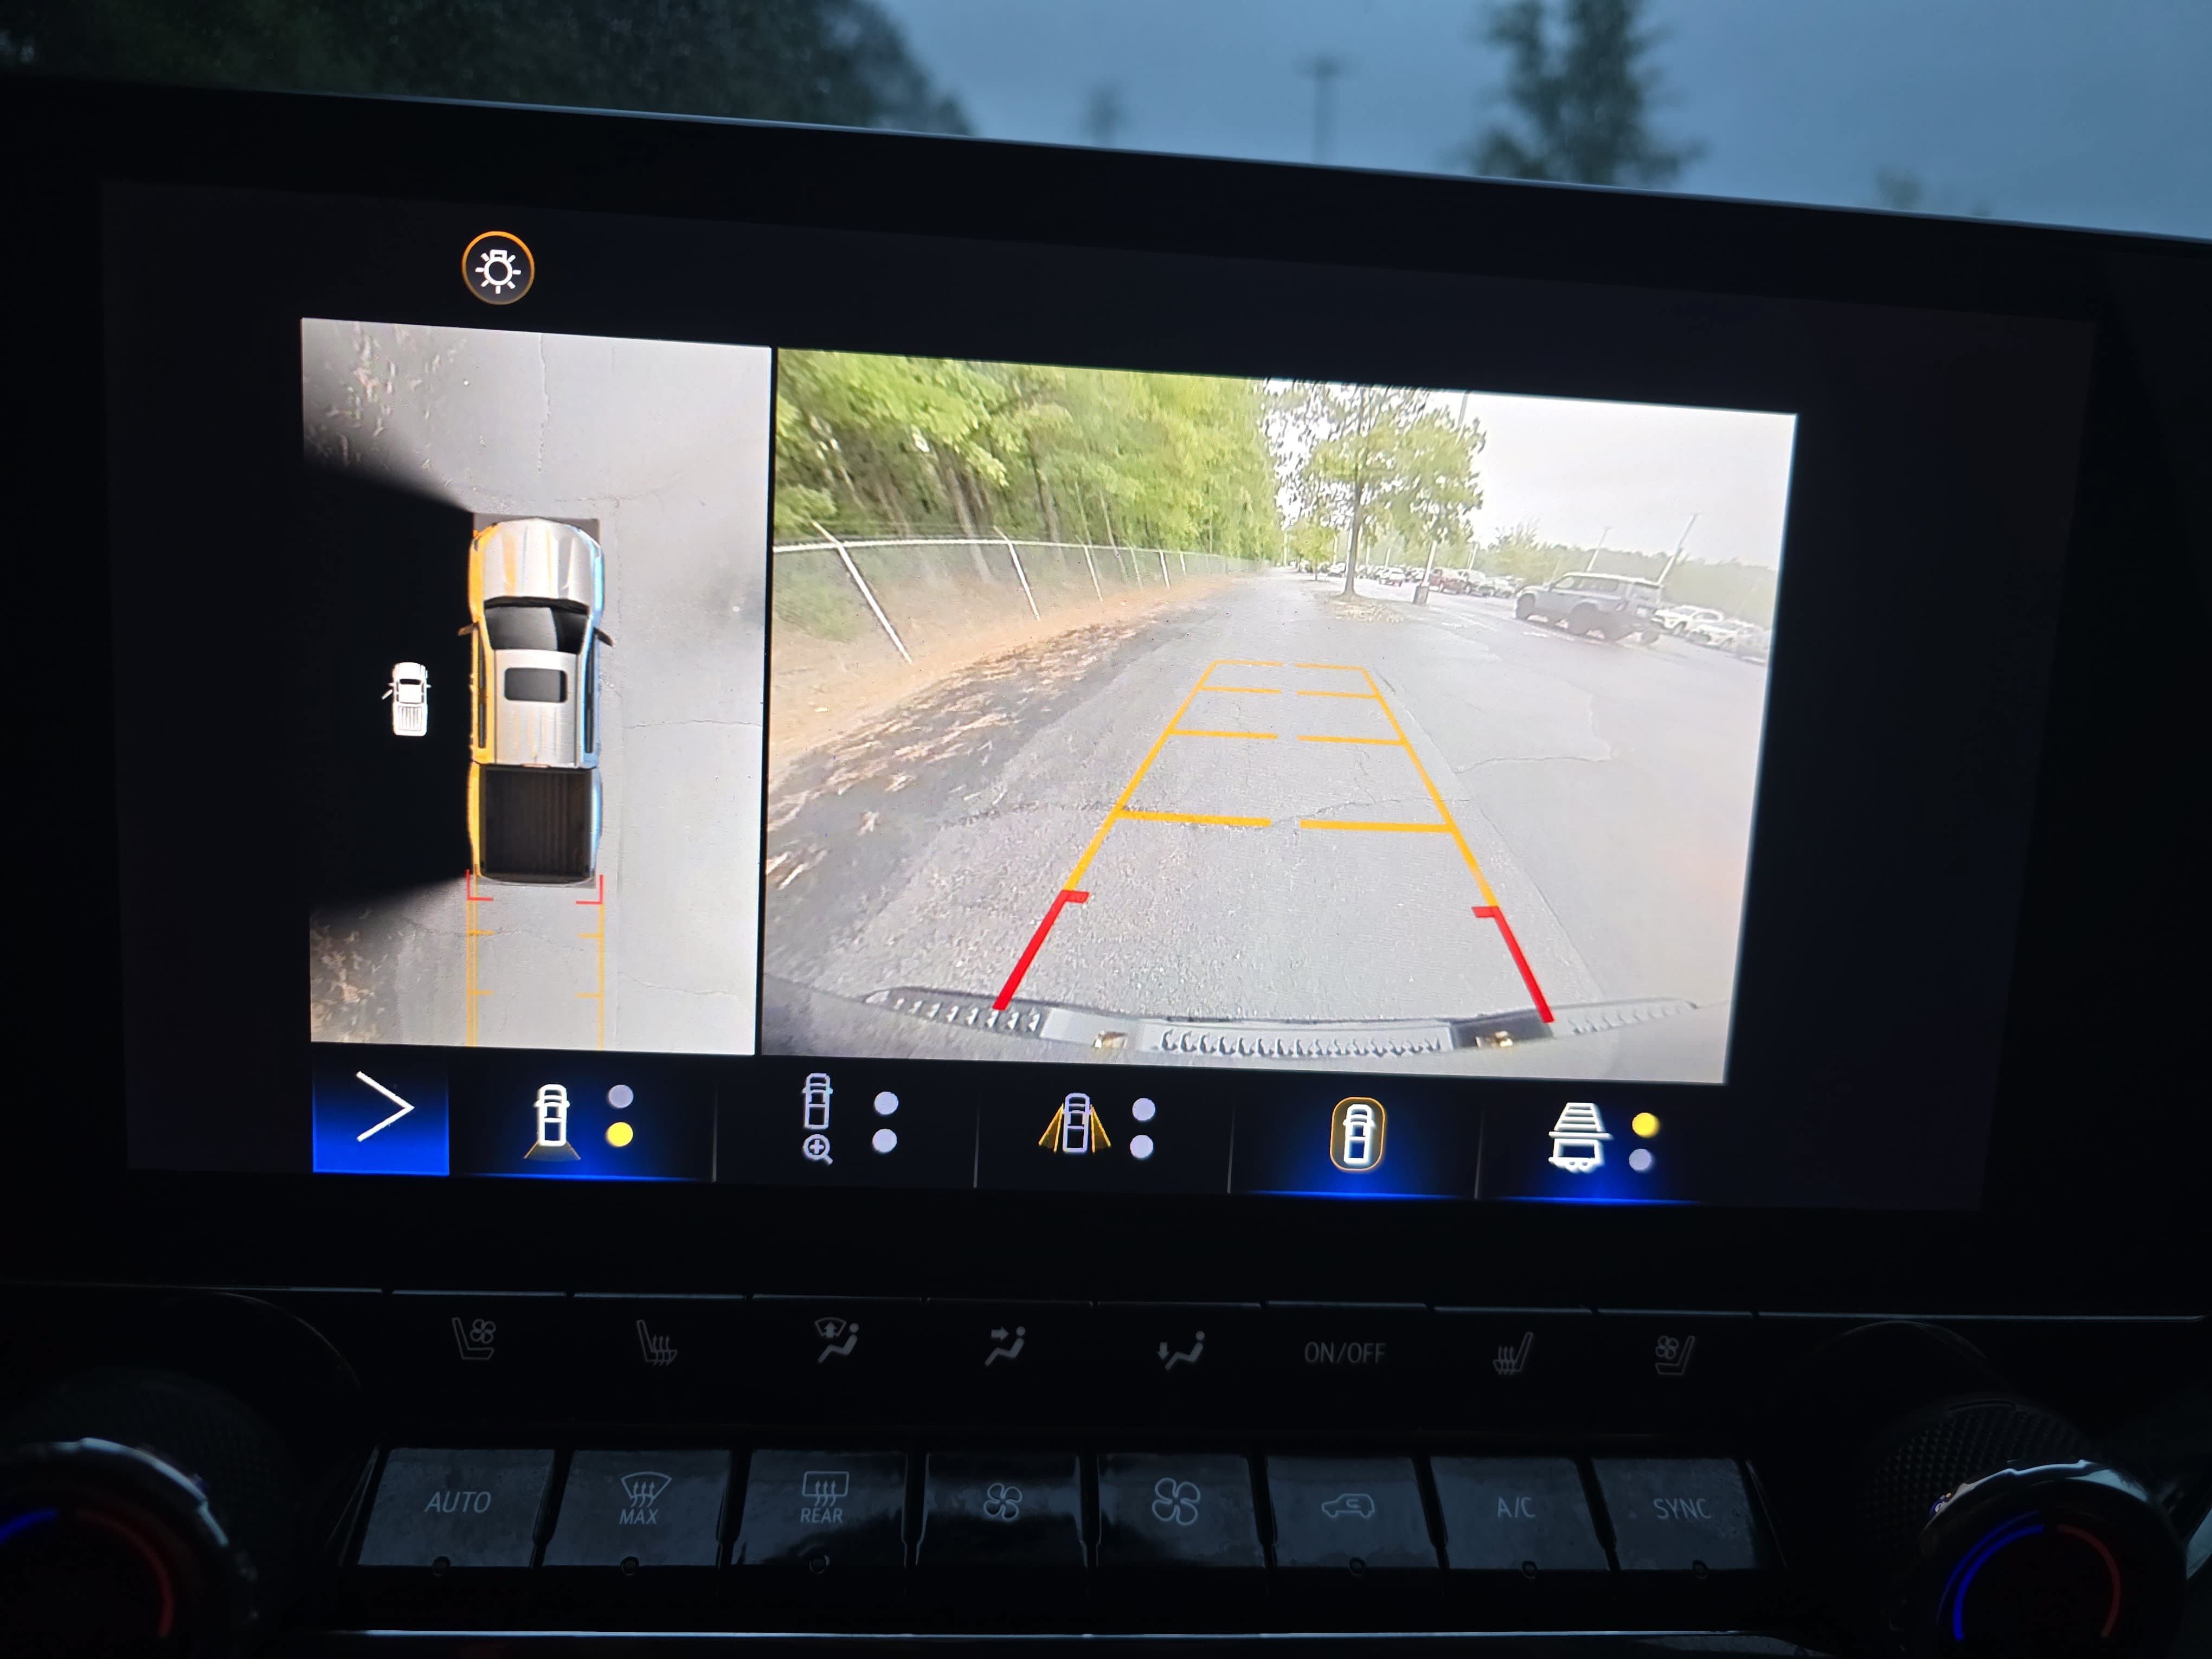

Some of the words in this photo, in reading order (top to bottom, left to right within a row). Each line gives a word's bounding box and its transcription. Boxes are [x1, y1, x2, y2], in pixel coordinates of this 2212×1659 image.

[1304, 1341, 1386, 1364] ON/OFF
[424, 1490, 492, 1514] AUTO
[1496, 1496, 1536, 1519] A/C
[1652, 1497, 1712, 1520] SYNC
[619, 1508, 659, 1525] MAX
[800, 1507, 844, 1524] REAR
